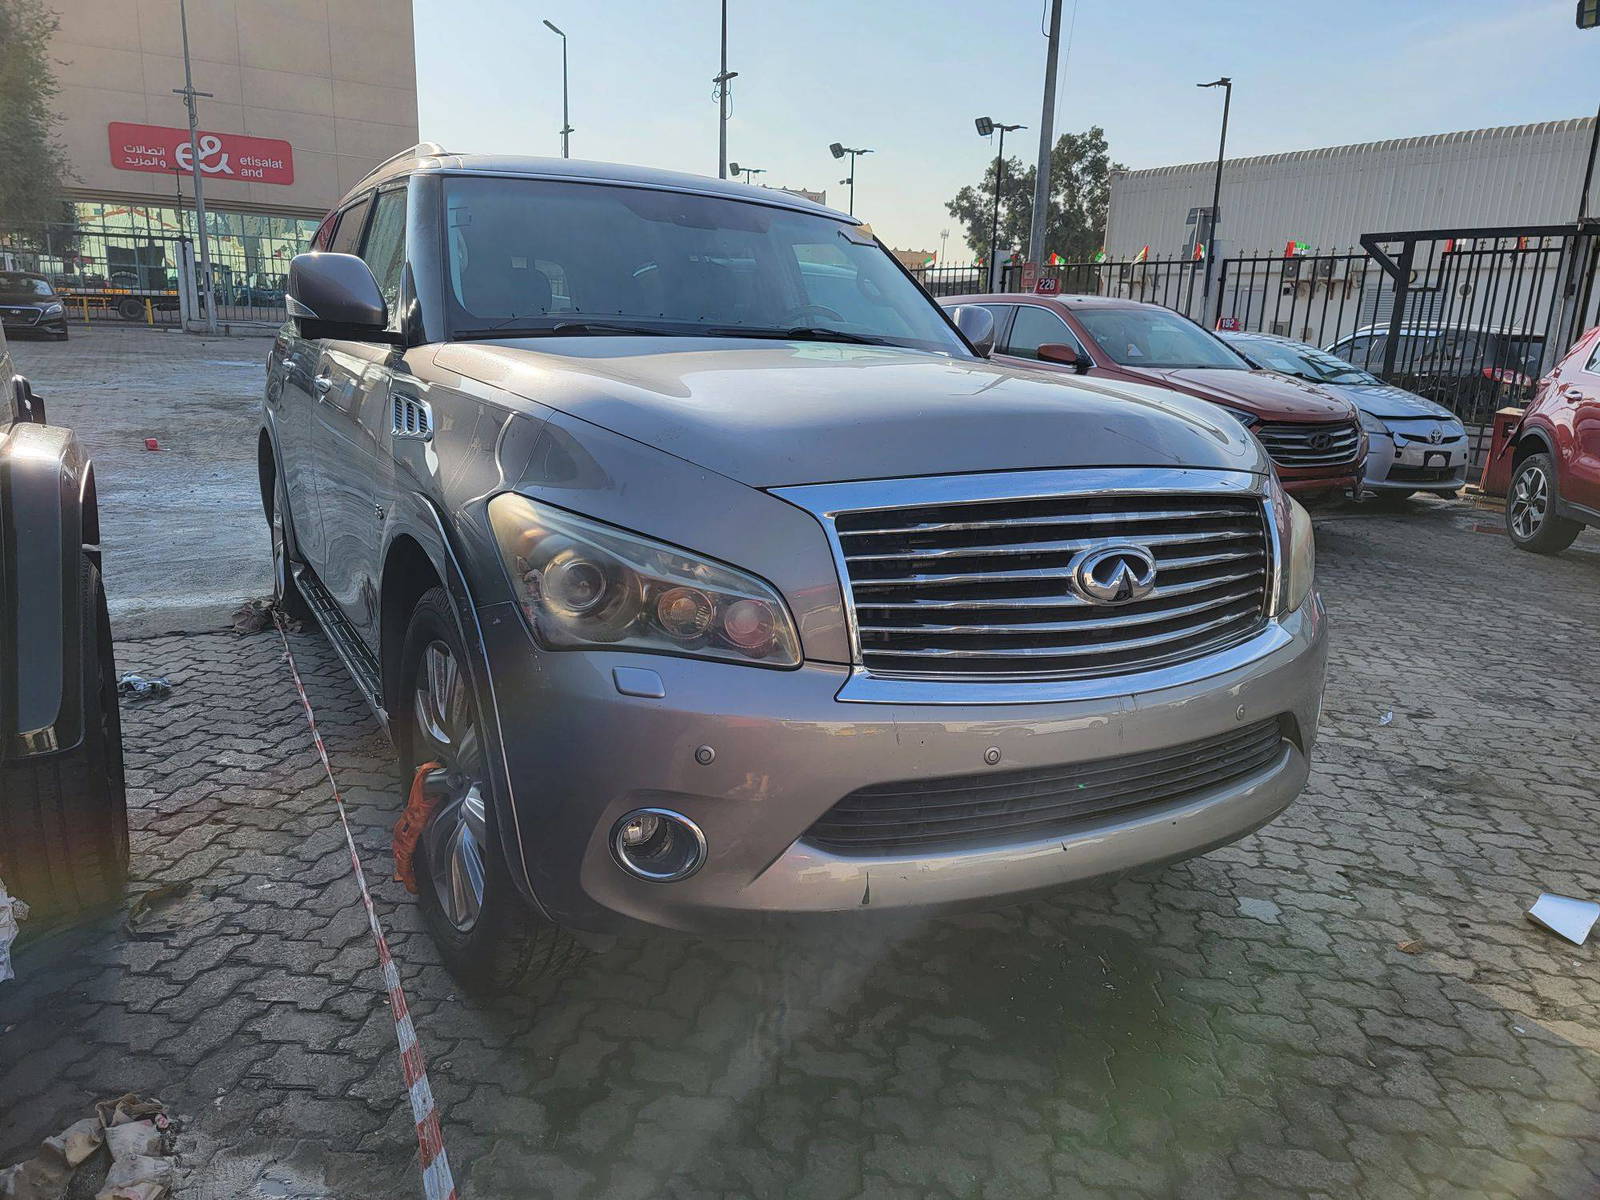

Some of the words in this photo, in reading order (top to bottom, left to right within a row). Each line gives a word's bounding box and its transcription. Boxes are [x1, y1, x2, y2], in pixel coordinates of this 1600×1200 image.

[123, 144, 165, 157] اتصالات
[240, 156, 284, 169] etisalat
[241, 168, 263, 178] and
[1039, 279, 1056, 290] 228
[1222, 318, 1235, 328] 192
